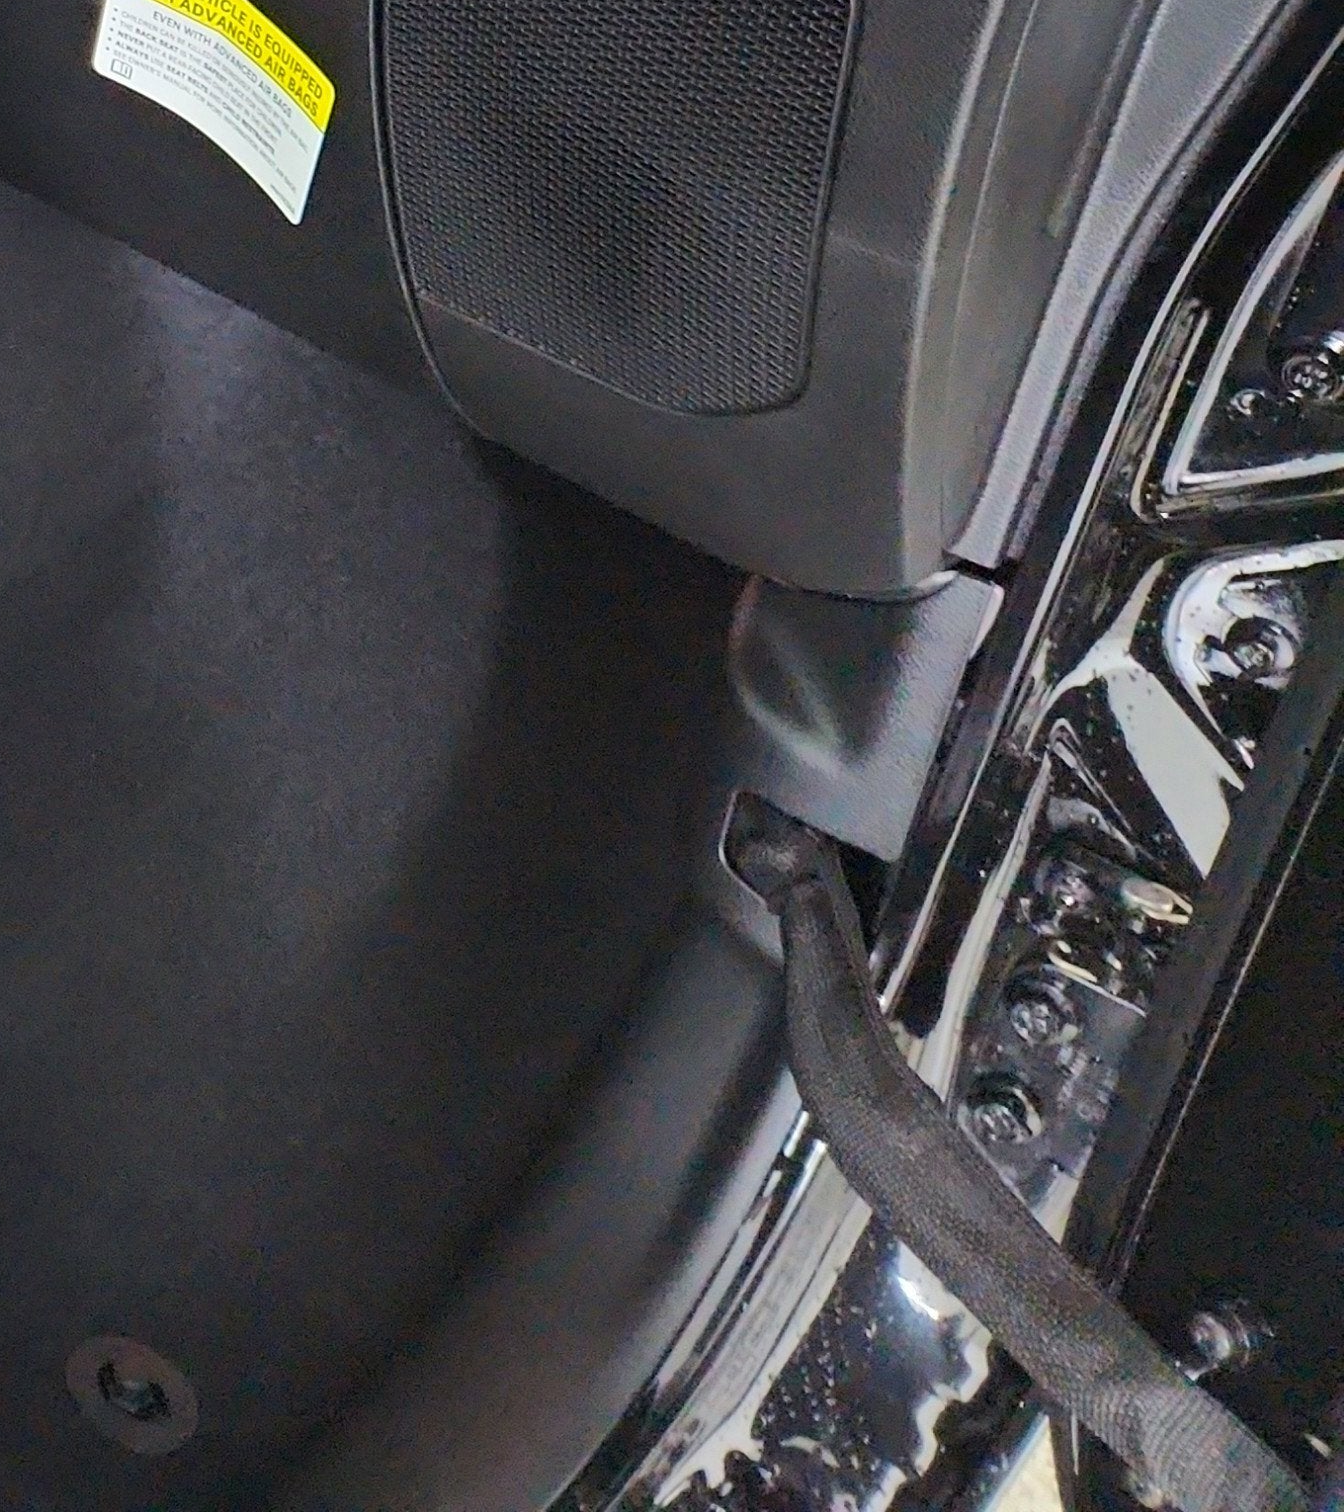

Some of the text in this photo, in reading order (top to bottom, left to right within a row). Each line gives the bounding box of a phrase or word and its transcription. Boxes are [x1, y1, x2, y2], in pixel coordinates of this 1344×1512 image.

[115, 41, 149, 60] ALWAYS
[118, 30, 144, 46] NEVER
[136, 28, 157, 43] BACK
[153, 11, 180, 31] EVEN
[184, 25, 211, 46] WITH
[213, 42, 257, 83] ADVANCED
[258, 80, 271, 94] AIR
[249, 19, 262, 39] IS
[264, 34, 323, 99] EQUIPPED
[264, 56, 286, 82] AIR
[288, 77, 318, 117] BAGS
